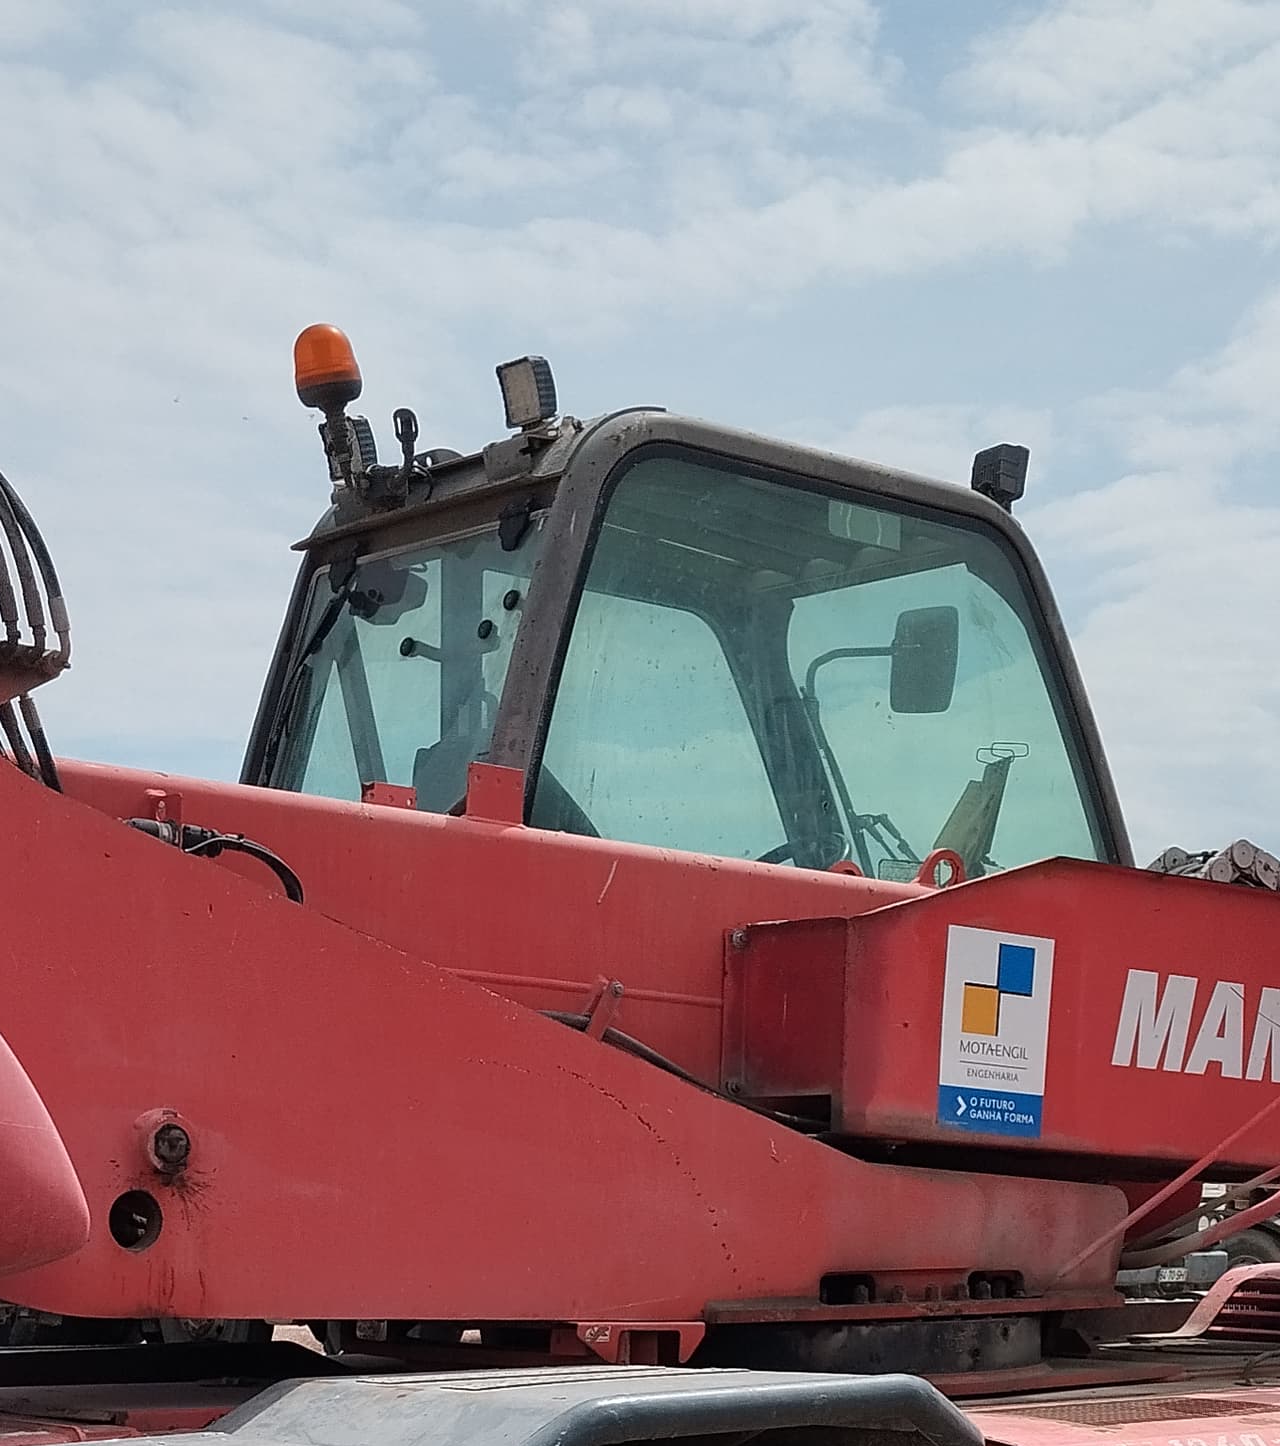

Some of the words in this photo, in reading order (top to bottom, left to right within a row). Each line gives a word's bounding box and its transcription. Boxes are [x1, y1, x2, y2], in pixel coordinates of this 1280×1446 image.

[967, 1067, 1018, 1082] ENGENHARIA
[970, 1097, 977, 1106] O
[980, 1097, 1015, 1110] FUTURO
[970, 1108, 1002, 1121] GANHA
[1004, 1111, 1034, 1124] FORMA
